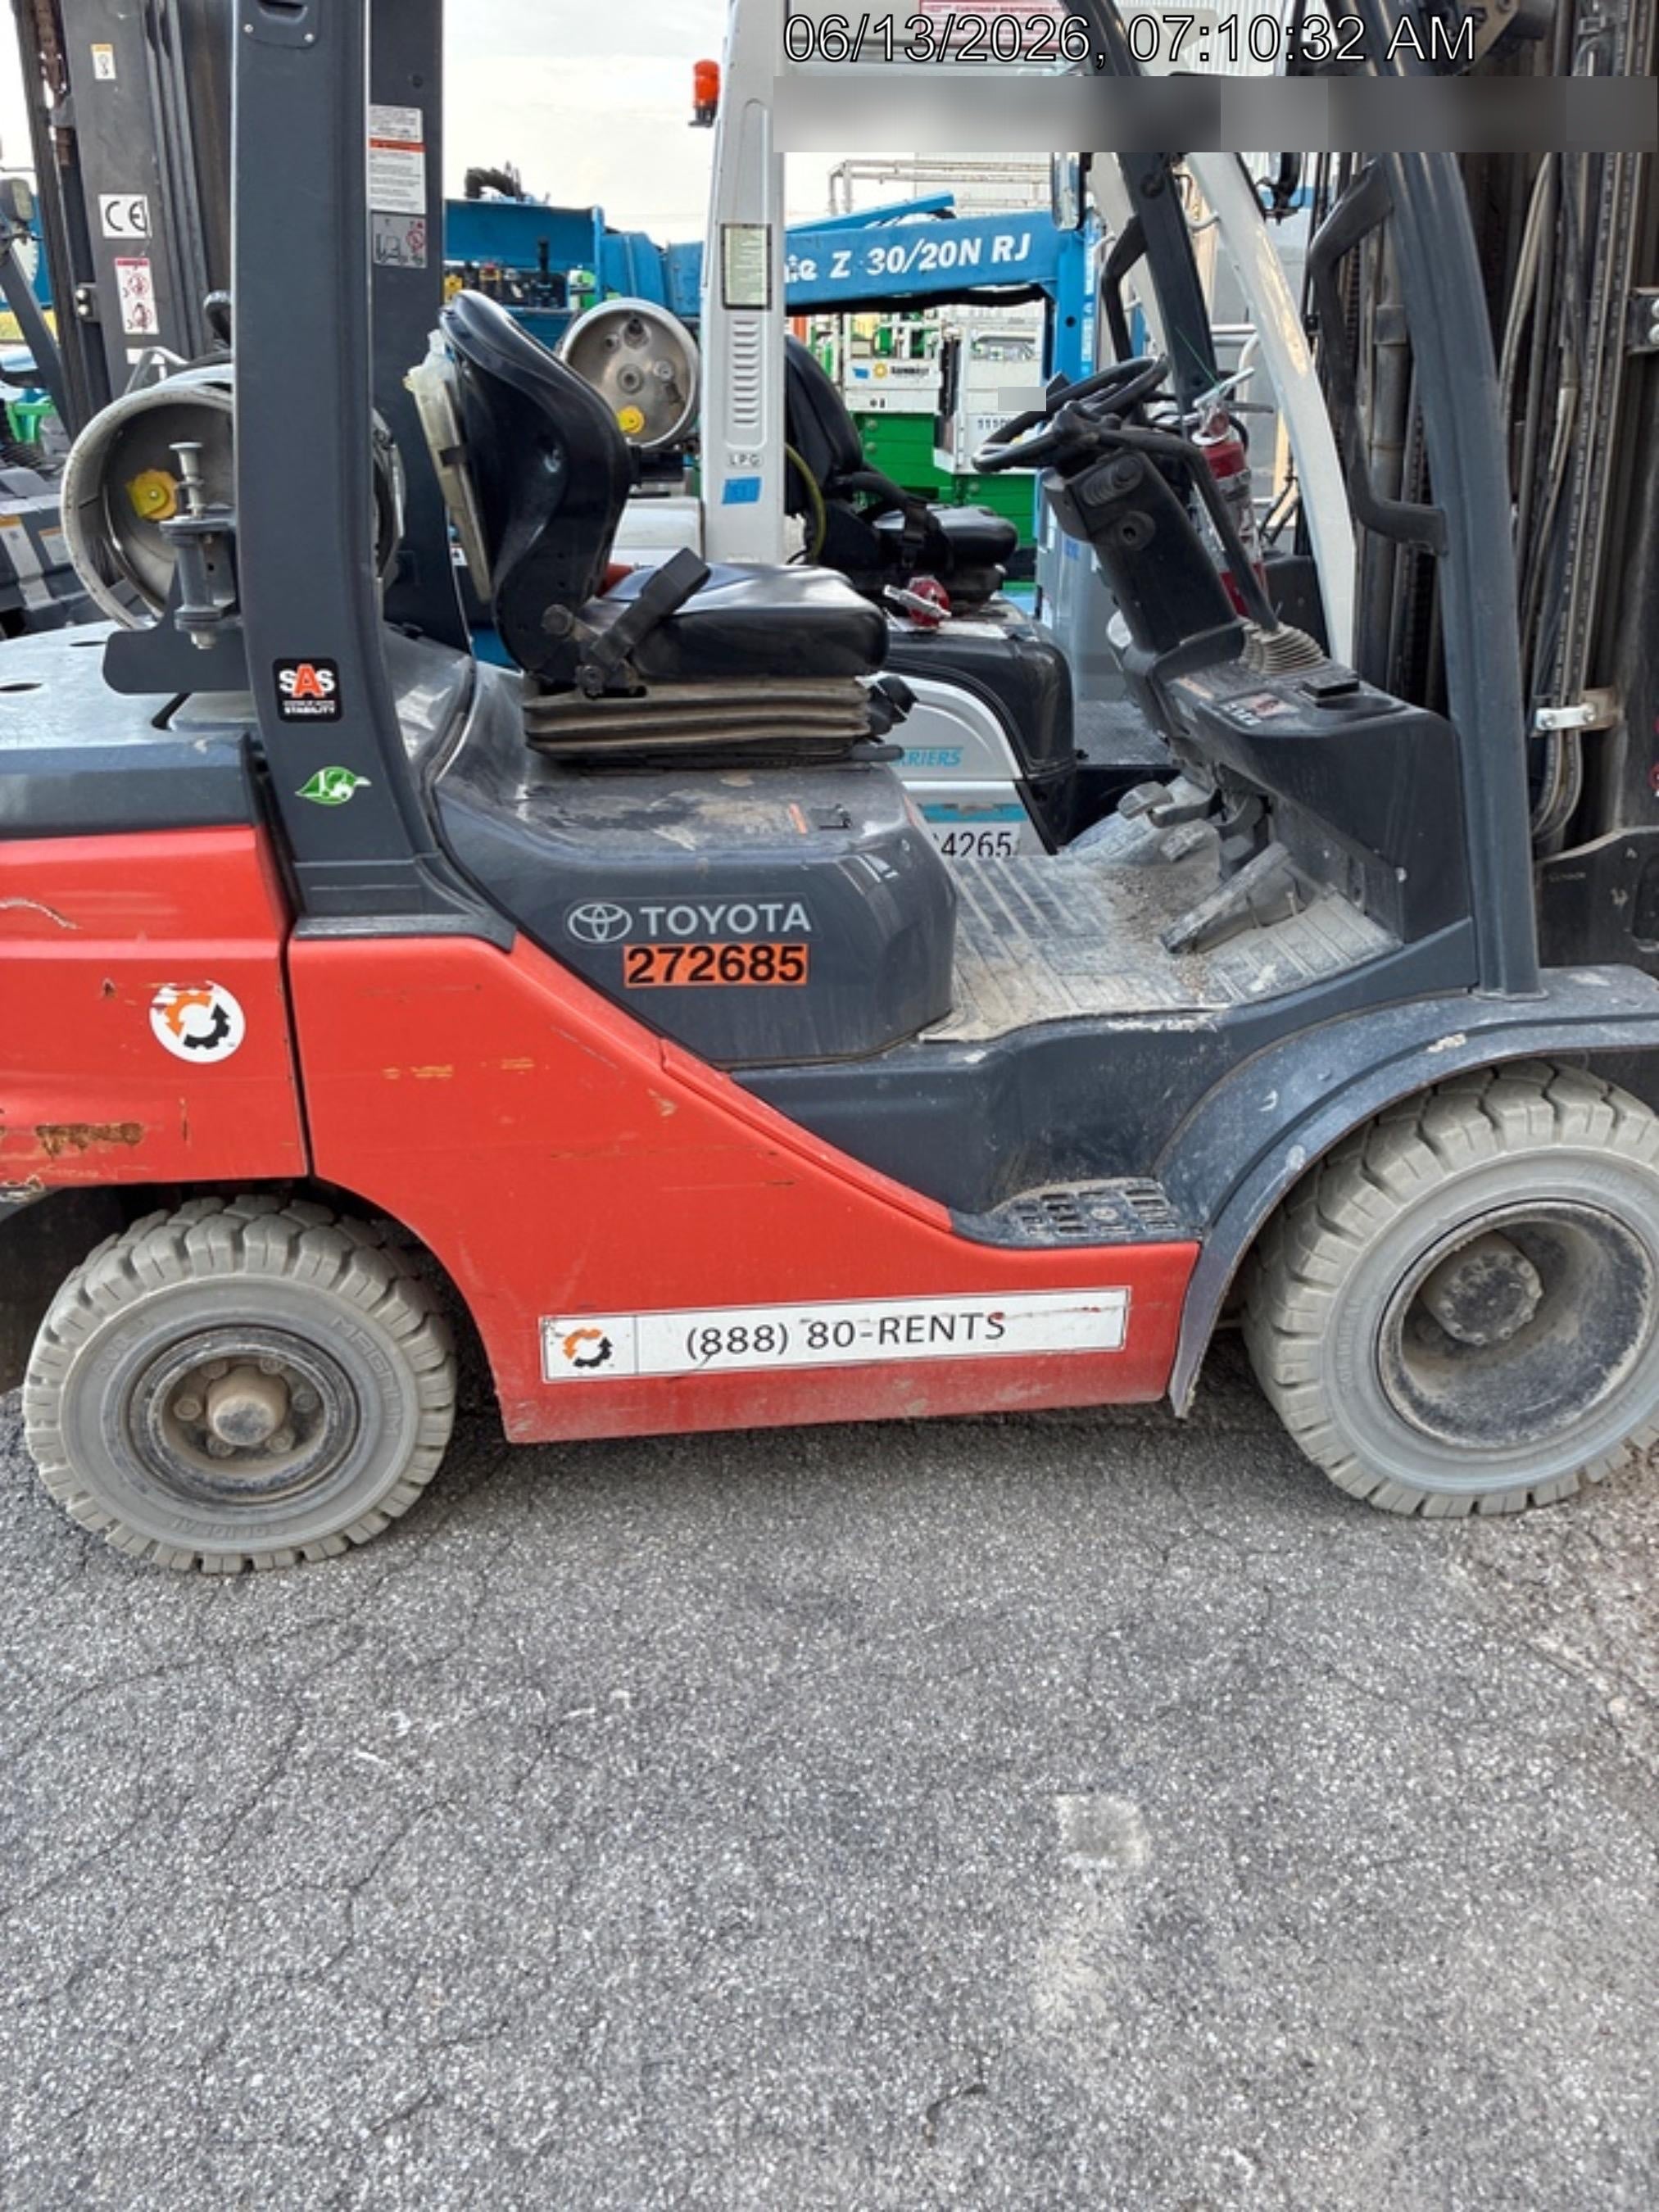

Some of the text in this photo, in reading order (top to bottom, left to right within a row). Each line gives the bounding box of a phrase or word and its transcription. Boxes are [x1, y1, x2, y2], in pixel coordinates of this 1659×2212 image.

[830, 250, 853, 279] Z
[866, 237, 983, 276] 30/20N
[990, 233, 1031, 263] RJ
[728, 452, 762, 467] LPG
[279, 663, 336, 698] SAS
[932, 831, 1013, 857] 4265
[639, 902, 812, 936] TOYOTA
[627, 945, 805, 984] 272685
[687, 1311, 1007, 1361] (888) 80-RENTS
[329, 1316, 406, 1438] MAGNUM
